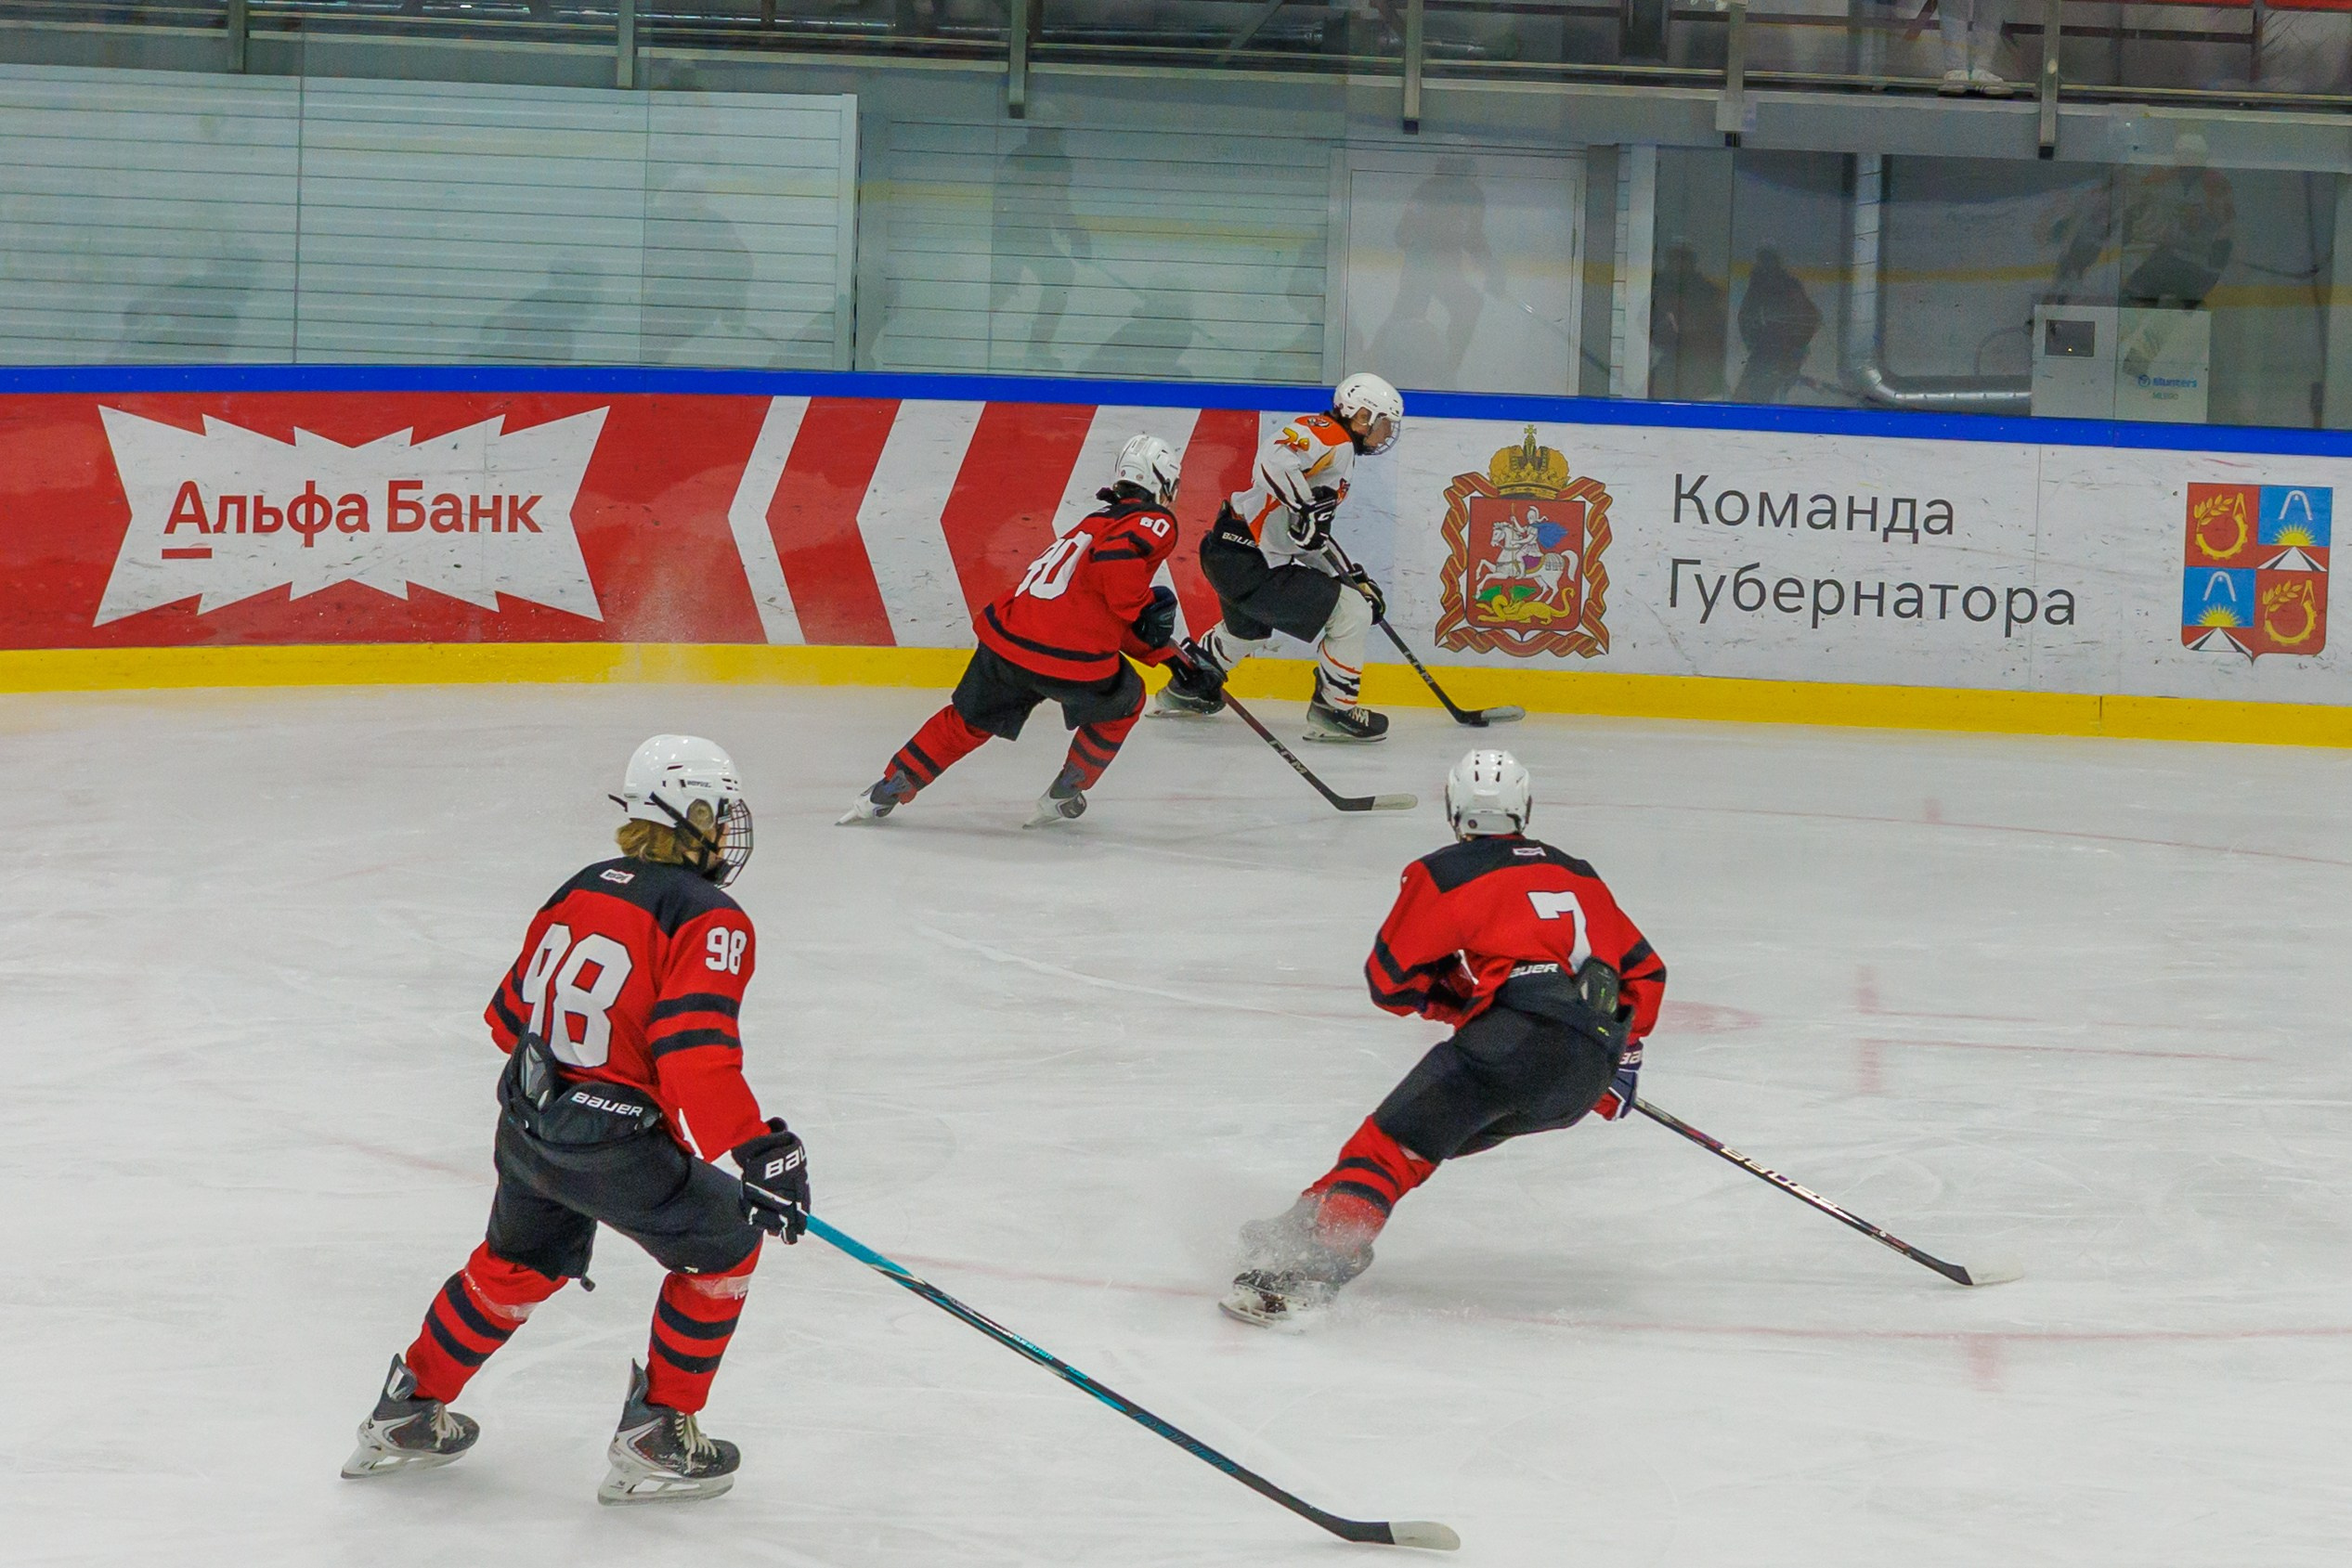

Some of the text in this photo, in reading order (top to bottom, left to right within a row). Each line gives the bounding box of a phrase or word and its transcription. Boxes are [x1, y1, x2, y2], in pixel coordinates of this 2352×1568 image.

[163, 480, 543, 548] Альфа Банк
[1673, 473, 1954, 544] Команда
[1670, 558, 2075, 638] Губернатора
[1268, 740, 1307, 774] CCM
[706, 927, 747, 976] 98
[1527, 890, 1592, 974] 7
[522, 922, 633, 1068] 98
[571, 1091, 644, 1117] BAUER
